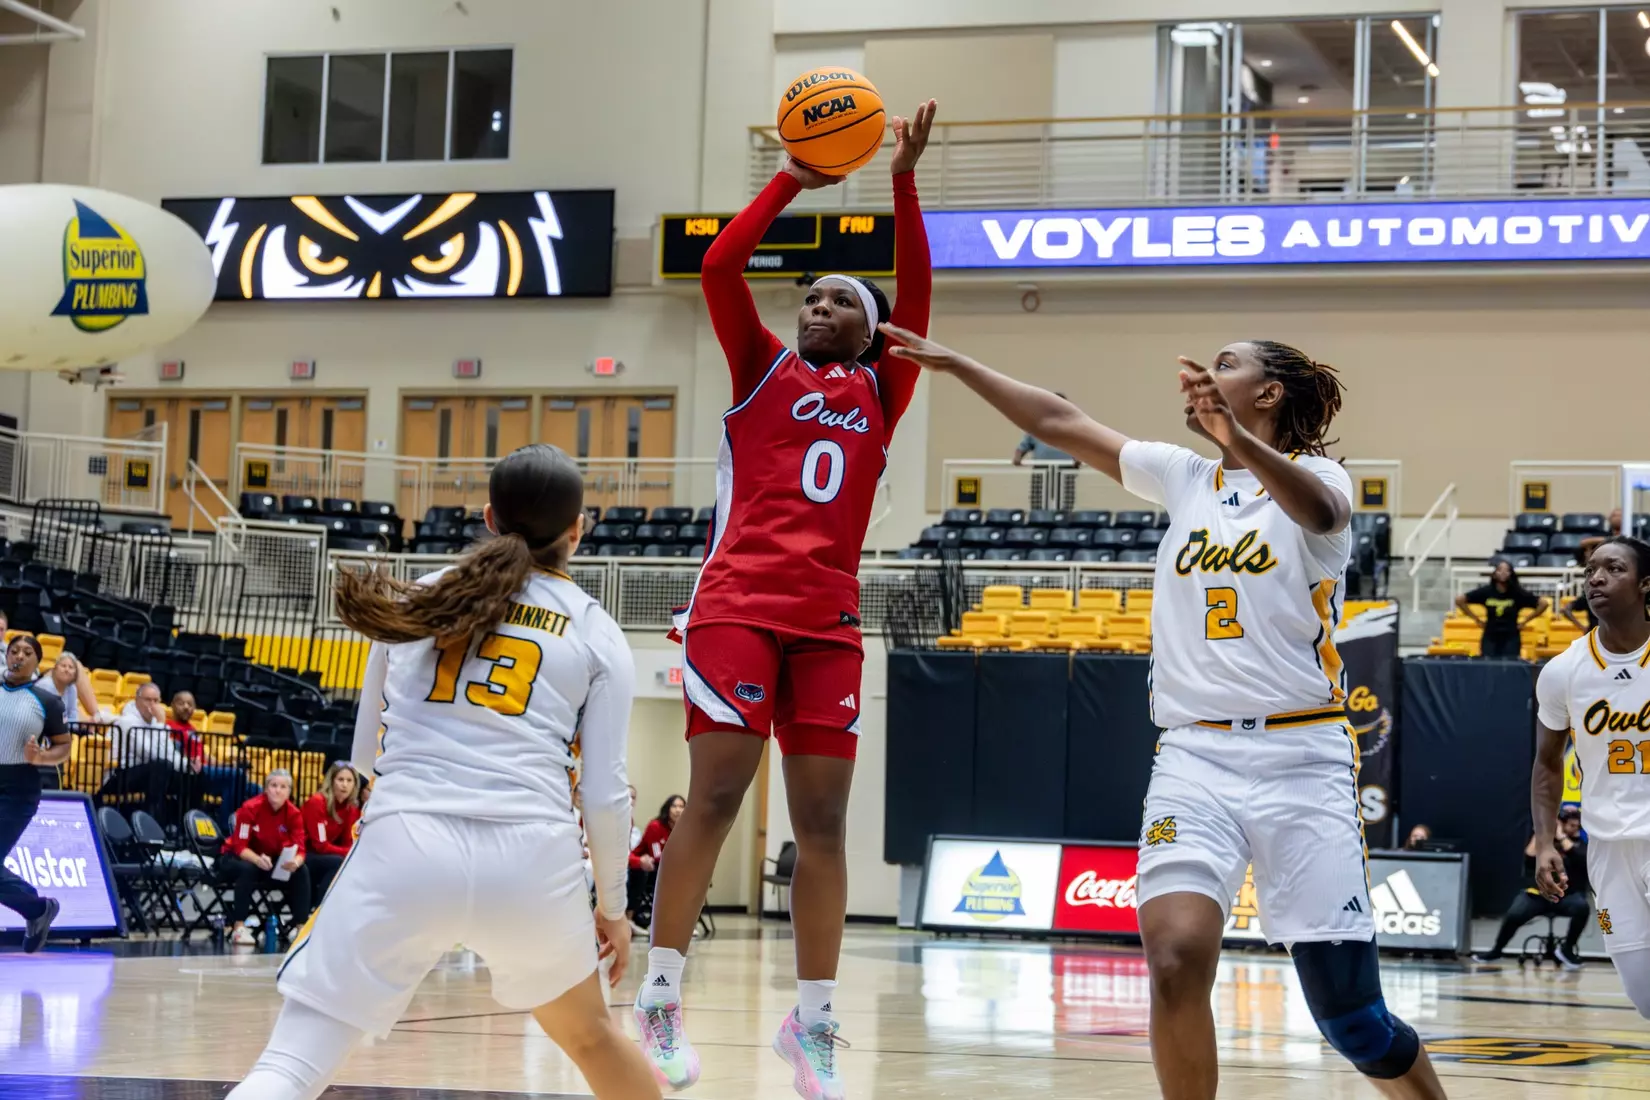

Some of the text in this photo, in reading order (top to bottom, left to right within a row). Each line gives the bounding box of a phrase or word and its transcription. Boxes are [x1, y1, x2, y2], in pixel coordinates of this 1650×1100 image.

[786, 72, 856, 102] Wilson
[802, 94, 857, 126] NCAA
[685, 218, 719, 236] KSU
[839, 216, 875, 234] FAU
[981, 214, 1650, 260] VOYLES AUTOMOTIV
[70, 242, 137, 276] Superior
[748, 255, 783, 268] PERIOD
[71, 282, 138, 311] PLUMBING
[790, 391, 870, 434] Owls
[801, 438, 846, 504] 0
[1175, 527, 1279, 577] Owls
[1204, 586, 1244, 640] 2
[424, 630, 543, 716] 13
[1348, 685, 1379, 712] Go
[1606, 738, 1650, 775] 21
